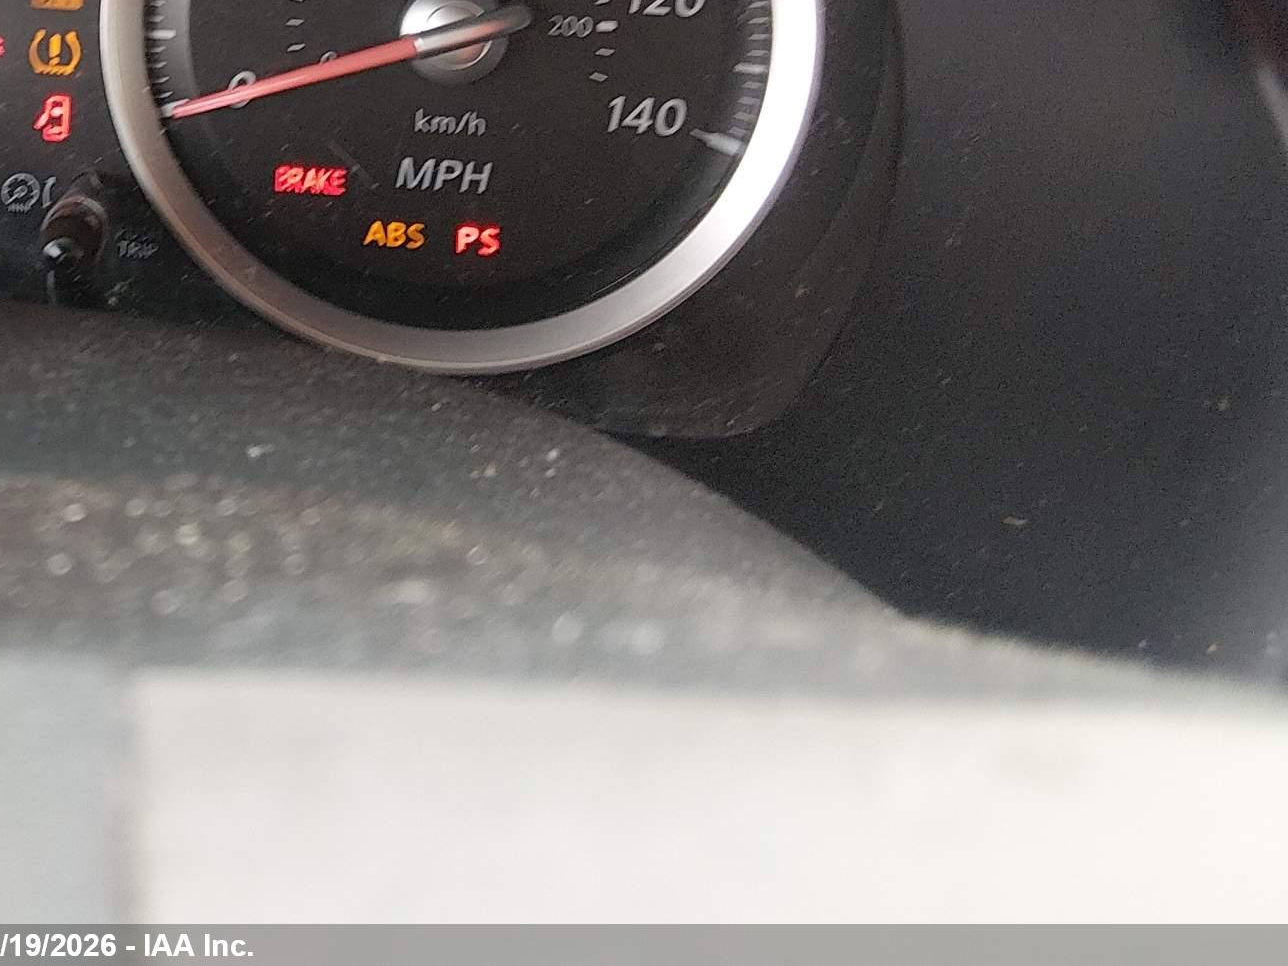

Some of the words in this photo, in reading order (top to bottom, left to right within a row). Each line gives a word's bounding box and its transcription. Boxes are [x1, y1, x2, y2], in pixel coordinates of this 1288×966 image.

[548, 15, 594, 37] 200
[414, 109, 487, 136] km/h
[607, 96, 687, 136] 140
[274, 166, 347, 196] BRAKE
[395, 157, 493, 194] MPH
[363, 220, 426, 248] ABS
[455, 224, 501, 255] PS
